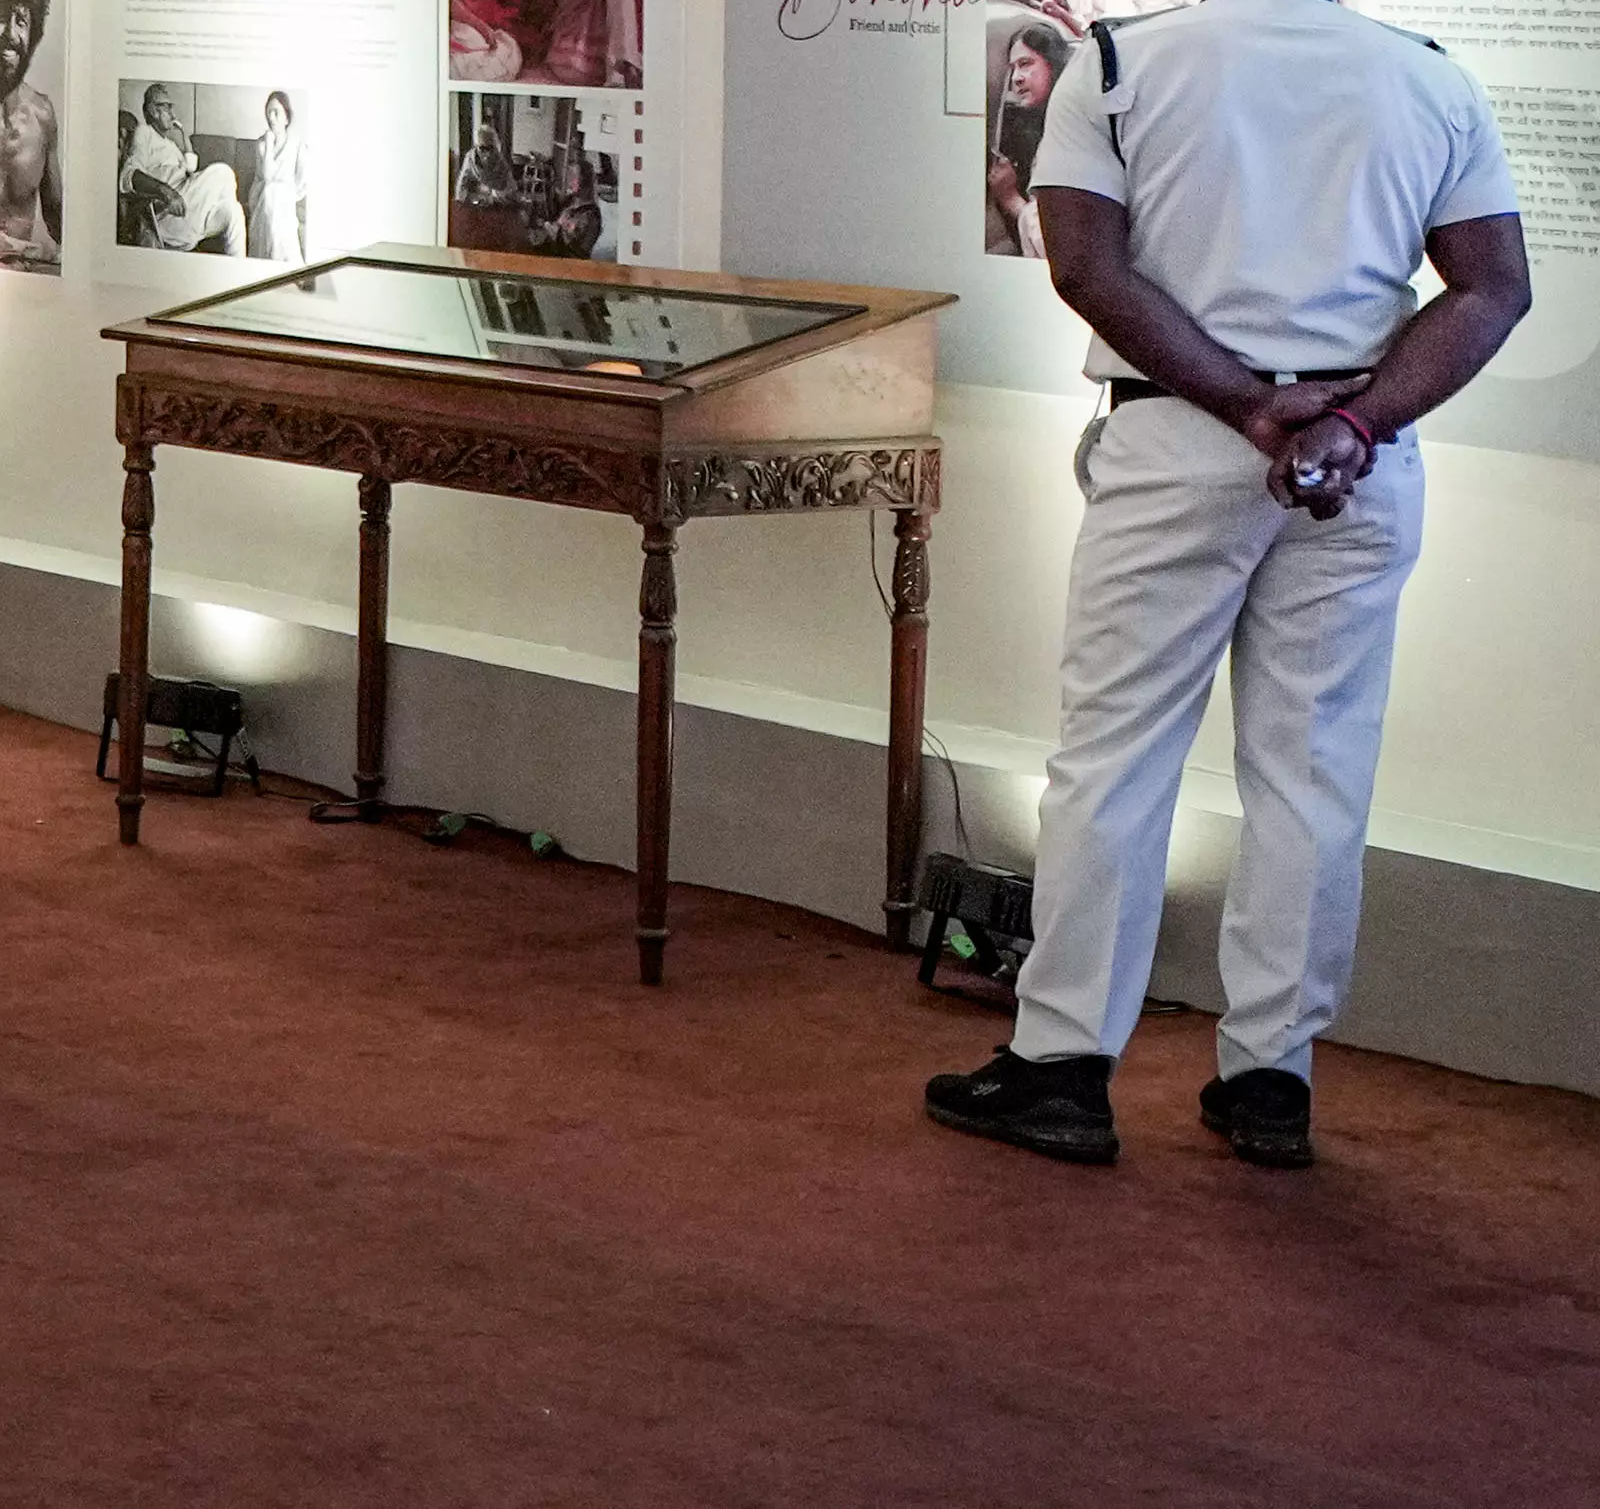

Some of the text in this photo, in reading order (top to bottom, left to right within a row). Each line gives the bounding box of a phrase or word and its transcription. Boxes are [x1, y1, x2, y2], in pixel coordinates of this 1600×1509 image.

[849, 18, 941, 35] Friend and Critic
